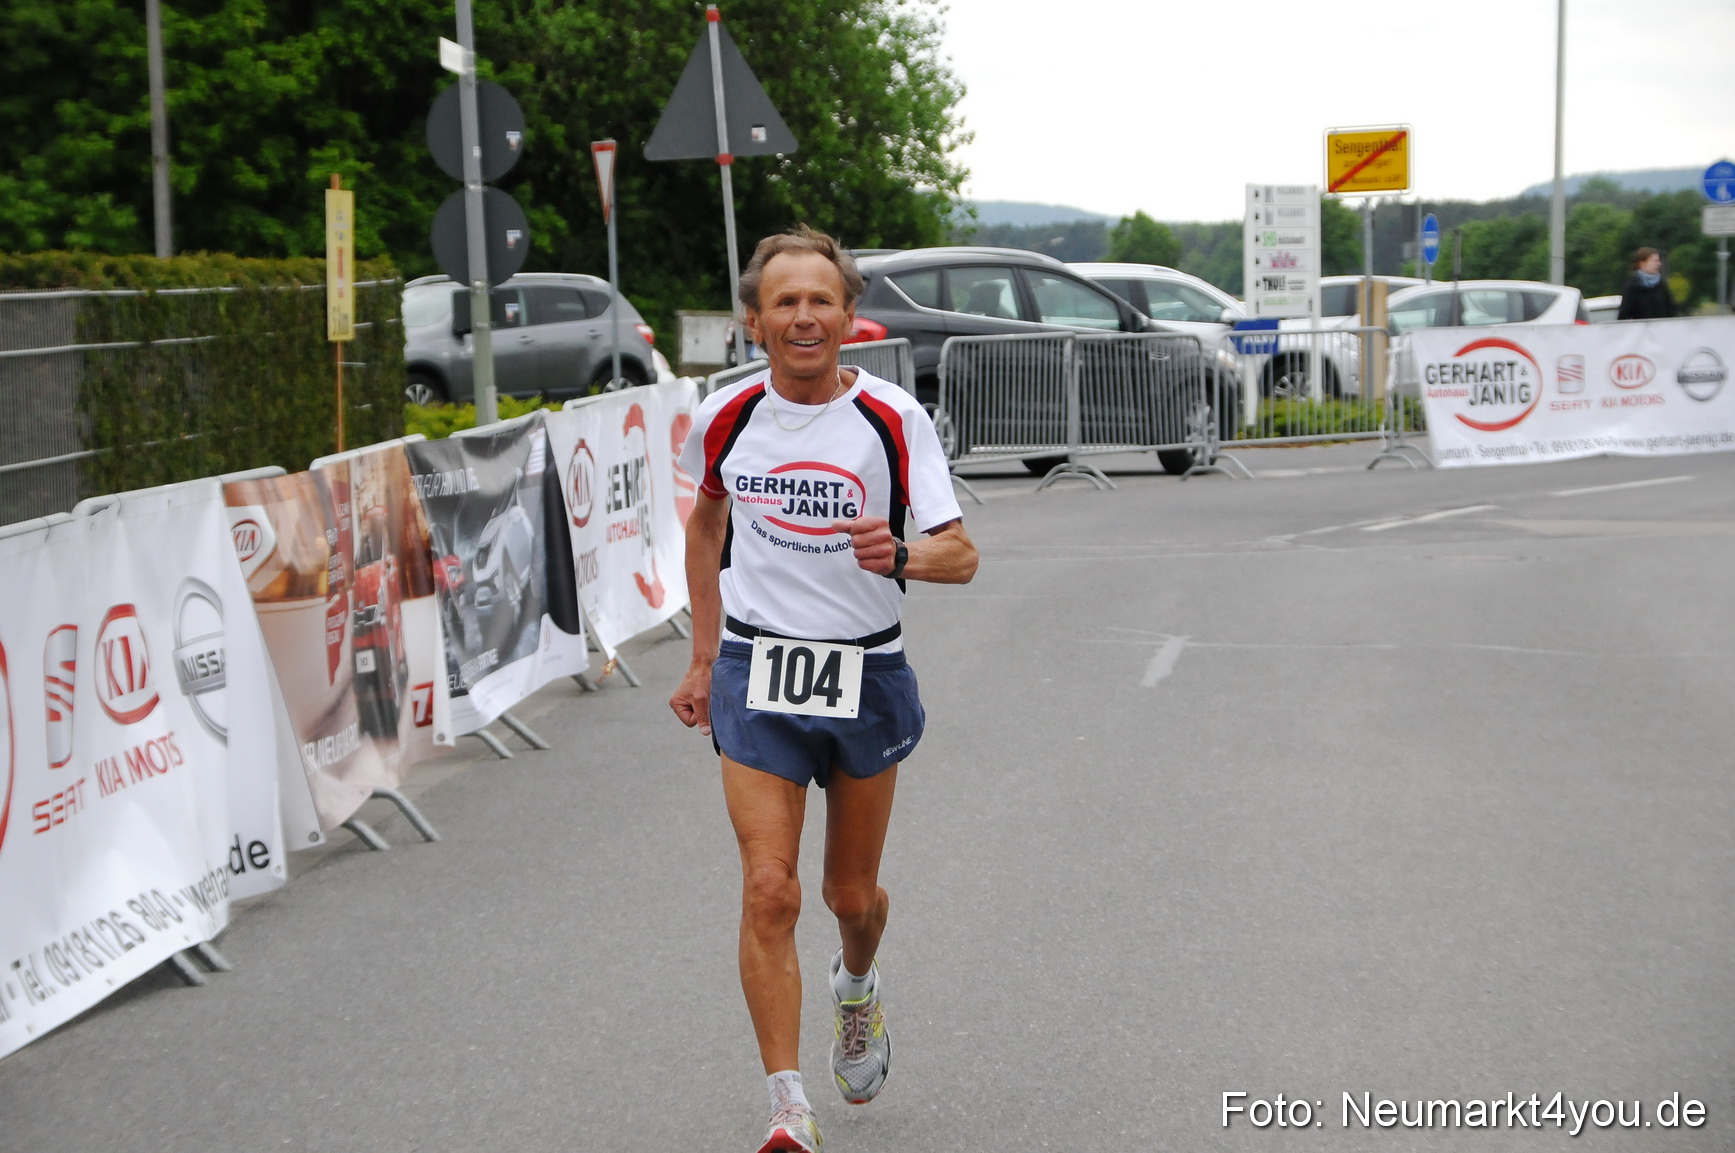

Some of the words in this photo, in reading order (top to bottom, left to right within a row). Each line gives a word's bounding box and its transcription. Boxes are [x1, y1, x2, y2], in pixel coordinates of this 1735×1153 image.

[1425, 361, 1519, 384] GERHART
[1616, 363, 1648, 381] KIA
[1427, 387, 1469, 398] Autohaus
[1602, 396, 1618, 408] KIA
[1621, 393, 1667, 407] MOTORS
[1550, 399, 1593, 411] SEAT
[735, 475, 844, 499] GERHART
[846, 489, 854, 499] &
[750, 520, 768, 539] Das
[768, 535, 821, 554] sportliche
[824, 537, 853, 554] Autoh
[180, 647, 226, 684] NISSA
[765, 645, 843, 708] 104
[31, 776, 86, 836] SEAT
[94, 755, 127, 799] KIA
